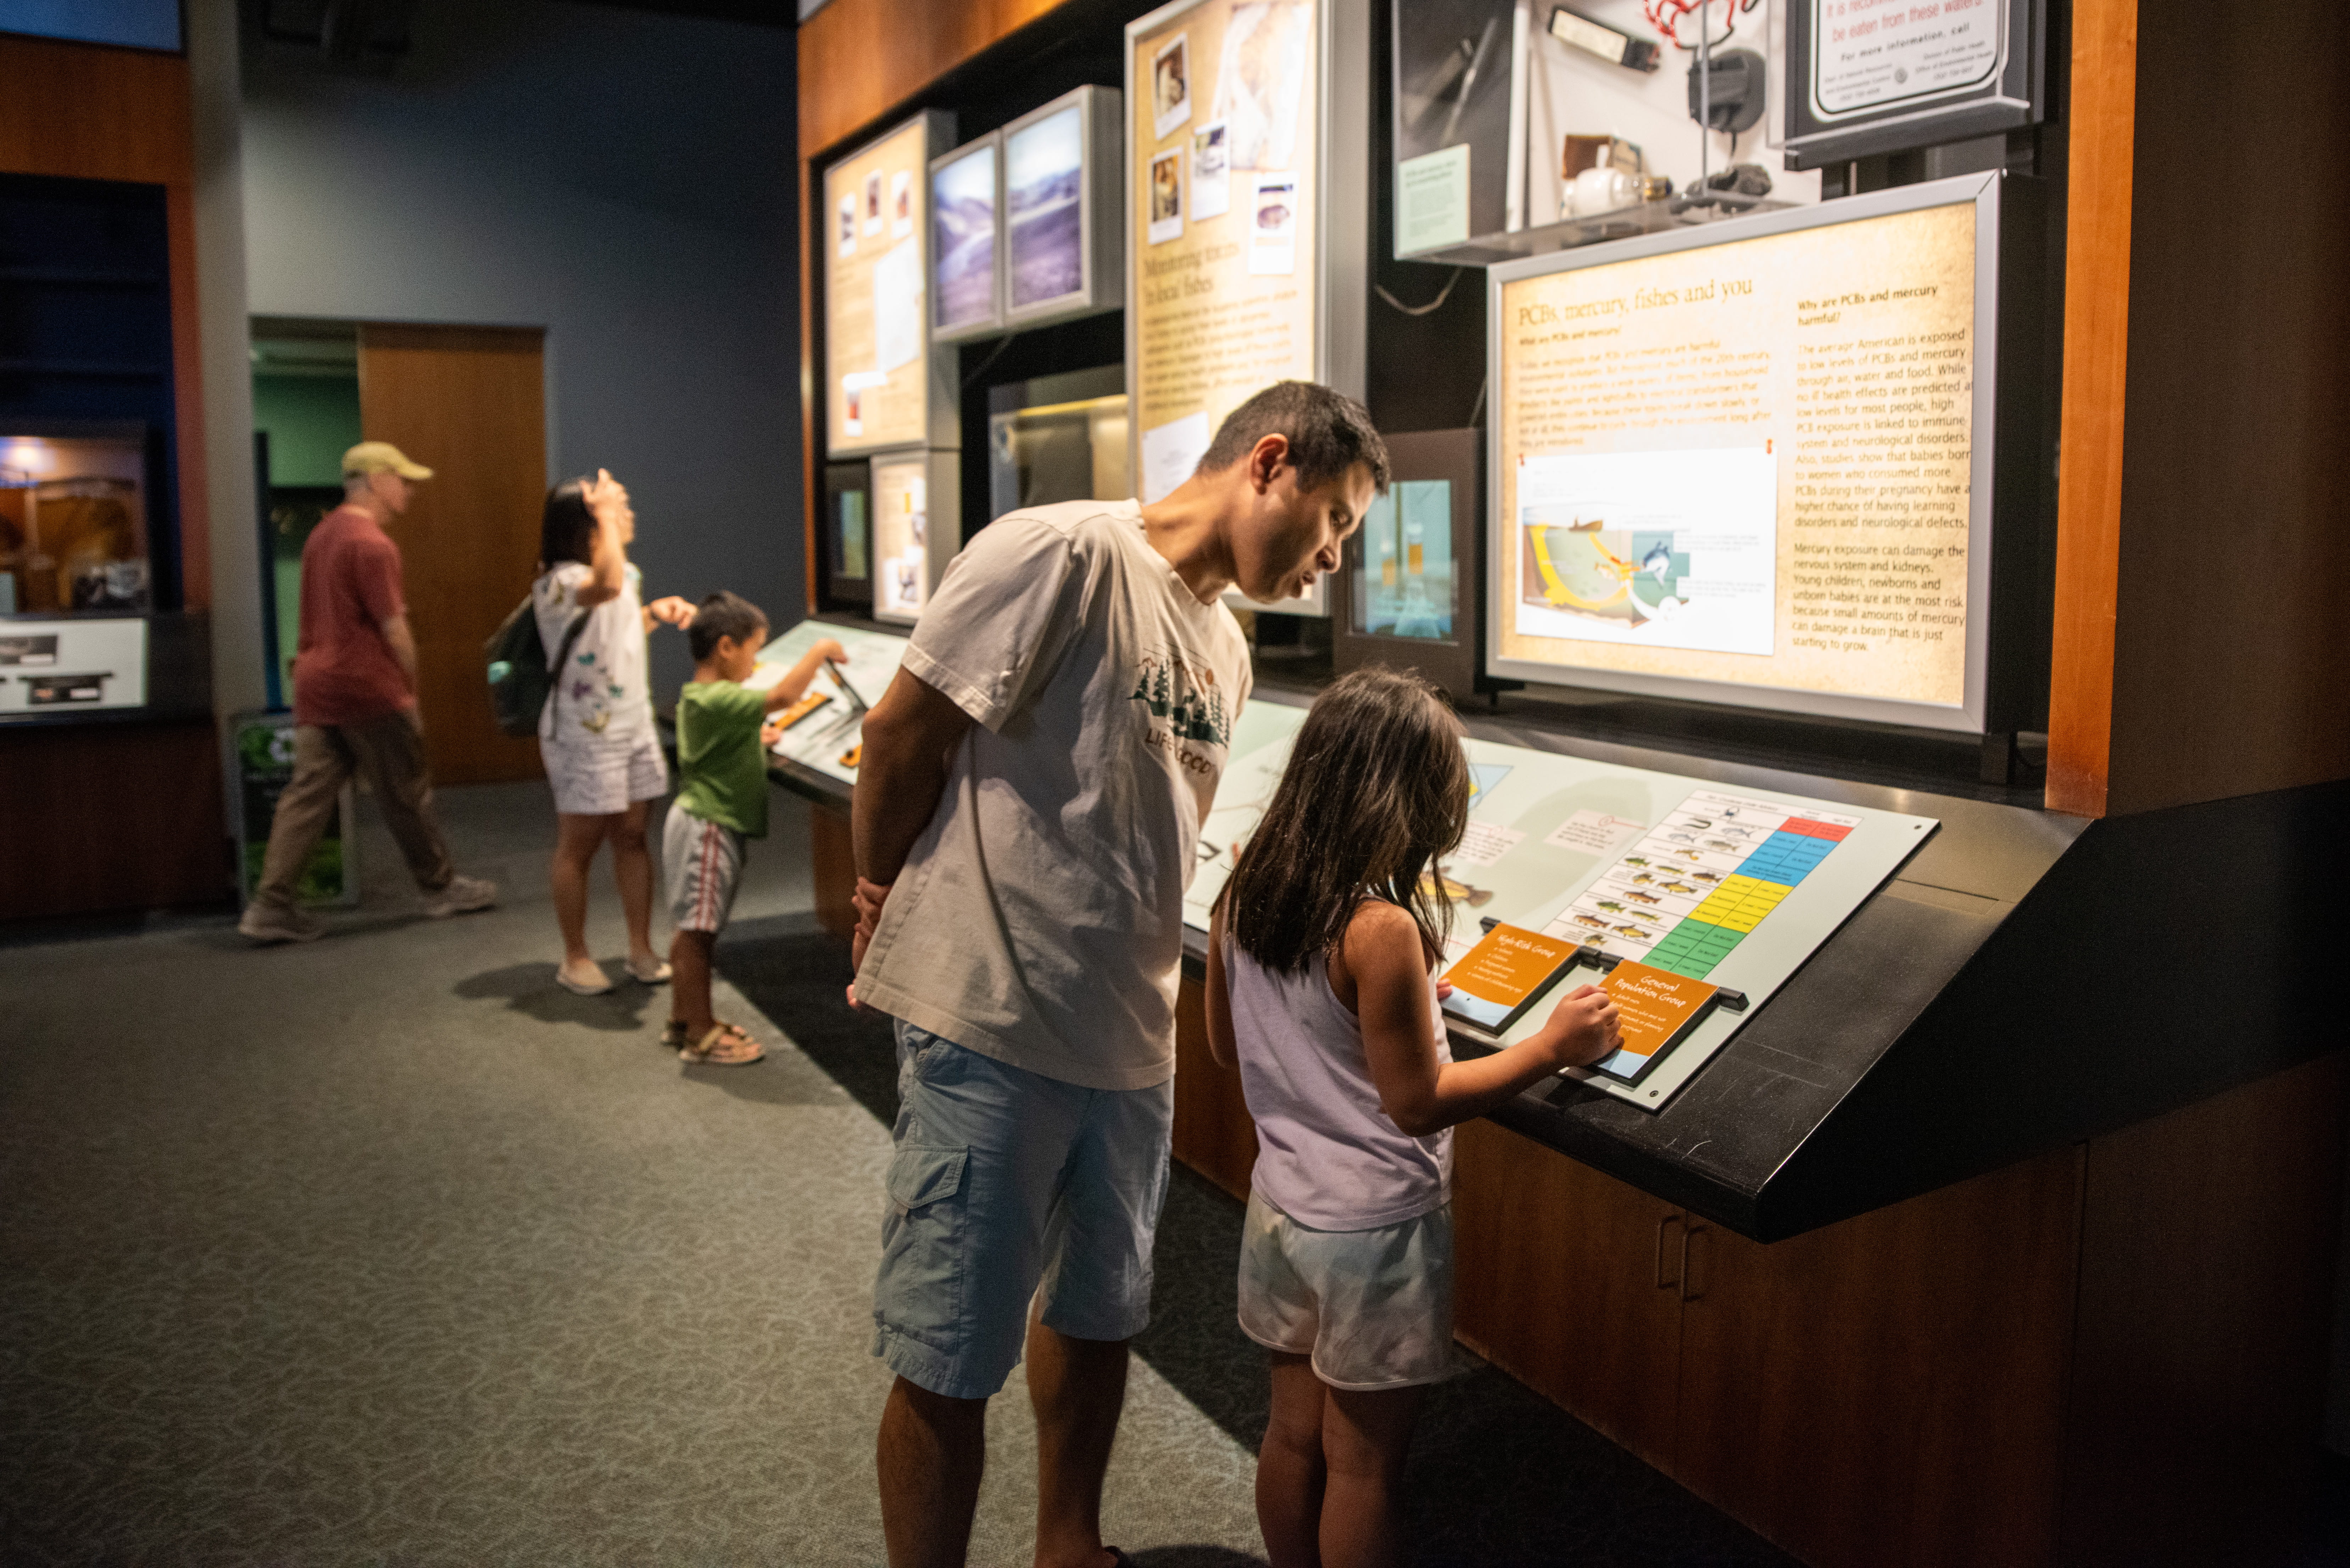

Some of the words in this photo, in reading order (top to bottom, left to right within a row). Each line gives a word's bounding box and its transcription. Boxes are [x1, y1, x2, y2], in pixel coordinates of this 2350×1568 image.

[1832, 27, 1845, 43] be
[1849, 19, 1878, 38] eaten
[1881, 11, 1905, 29] from
[1909, 4, 1939, 23] these
[1841, 53, 1855, 61] For
[1859, 46, 1882, 58] more
[1950, 22, 1970, 36] call
[1565, 297, 1631, 322] mercury,
[1635, 287, 1679, 310] fishes
[1684, 278, 1715, 303] and
[1721, 279, 1753, 304] you
[1797, 299, 1818, 311] Why
[1821, 298, 1838, 309] are
[1840, 292, 1866, 306] PCBs
[1869, 288, 1890, 303] and
[1892, 285, 1939, 300] mercury
[1798, 344, 1815, 355] The
[1818, 342, 1854, 354] average
[1858, 336, 1905, 349] American
[1908, 335, 1916, 345] is
[1919, 328, 1966, 344] exposed
[1797, 362, 1807, 371] to
[1829, 357, 1855, 368] levels
[1859, 354, 1868, 366] of
[1871, 352, 1895, 364] PCBs
[1899, 350, 1919, 362] and
[1922, 347, 1966, 359] mercury
[1854, 372, 1880, 382] water
[1884, 368, 1904, 380] and
[1937, 363, 1966, 376] While
[1795, 393, 1809, 402] no
[1822, 389, 1851, 401] health
[1855, 386, 1888, 397] effects
[1892, 386, 1908, 396] are
[1911, 380, 1960, 396] predicted
[1815, 406, 1841, 416] levels
[1844, 404, 1858, 415] for
[1861, 404, 1886, 414] most
[1931, 398, 1954, 413] high
[1796, 422, 1814, 433] PCB
[1816, 422, 1860, 435] exposure
[1864, 422, 1871, 430] is
[1875, 418, 1905, 429] linked
[1908, 418, 1919, 428] to
[1922, 417, 1965, 427] immune
[1797, 440, 1827, 450] system
[1831, 437, 1849, 448] and
[1852, 434, 1913, 447] neurological
[1917, 431, 1968, 445] disorders.
[1821, 453, 1853, 464] studies
[1859, 453, 1882, 462] show
[1887, 451, 1906, 462] that
[1910, 450, 1943, 461] babies
[1794, 471, 1805, 480] to
[1808, 471, 1841, 480] women
[1845, 470, 1865, 479] who
[1869, 467, 1919, 478] consumed
[1924, 468, 1951, 478] more
[1794, 484, 1817, 496] PCBs
[1820, 485, 1851, 498] during
[1854, 485, 1874, 495] their
[1880, 485, 1932, 497] pregnancy
[1937, 483, 1961, 495] have
[1794, 500, 1824, 515] higher
[1827, 500, 1859, 512] chance
[1863, 500, 1873, 510] of
[1876, 500, 1909, 514] having
[1913, 501, 1956, 514] learning
[1793, 515, 1838, 528] disorders
[1839, 515, 1858, 528] and
[1862, 516, 1923, 530] neurological
[1926, 516, 1968, 529] defects.
[1793, 542, 1831, 556] Mercury
[1833, 545, 1878, 556] exposure
[1882, 546, 1900, 556] can
[1903, 544, 1945, 560] damage
[1947, 543, 1966, 558] the
[1792, 559, 1830, 570] nervous
[1833, 560, 1867, 571] system
[1869, 560, 1889, 571] and
[1892, 560, 1934, 575] kidneys.
[1792, 573, 1822, 587] Young
[1869, 576, 1917, 589] newborns
[1920, 577, 1942, 591] and
[1792, 589, 1826, 601] unborn
[1829, 591, 1860, 603] babies
[1863, 595, 1879, 604] are
[1895, 594, 1911, 606] the
[1915, 596, 1941, 607] most
[1945, 594, 1963, 608] risk
[1792, 603, 1830, 616] because
[1833, 607, 1858, 618] small
[1861, 610, 1904, 622] amounts
[1907, 610, 1918, 623] of
[1921, 611, 1964, 627] mercury
[1791, 621, 1808, 631] can
[1811, 622, 1848, 636] damage
[1860, 625, 1886, 636] brain
[1889, 626, 1909, 639] that
[1912, 630, 1921, 639] is
[1923, 630, 1943, 642] just
[1792, 636, 1827, 651] starting
[1830, 639, 1840, 649] to
[1498, 934, 1532, 950] High-Risk
[1531, 945, 1556, 959] Group
[1615, 978, 1658, 998] Population
[1659, 993, 1687, 1008] Group
[1641, 976, 1680, 992] General
